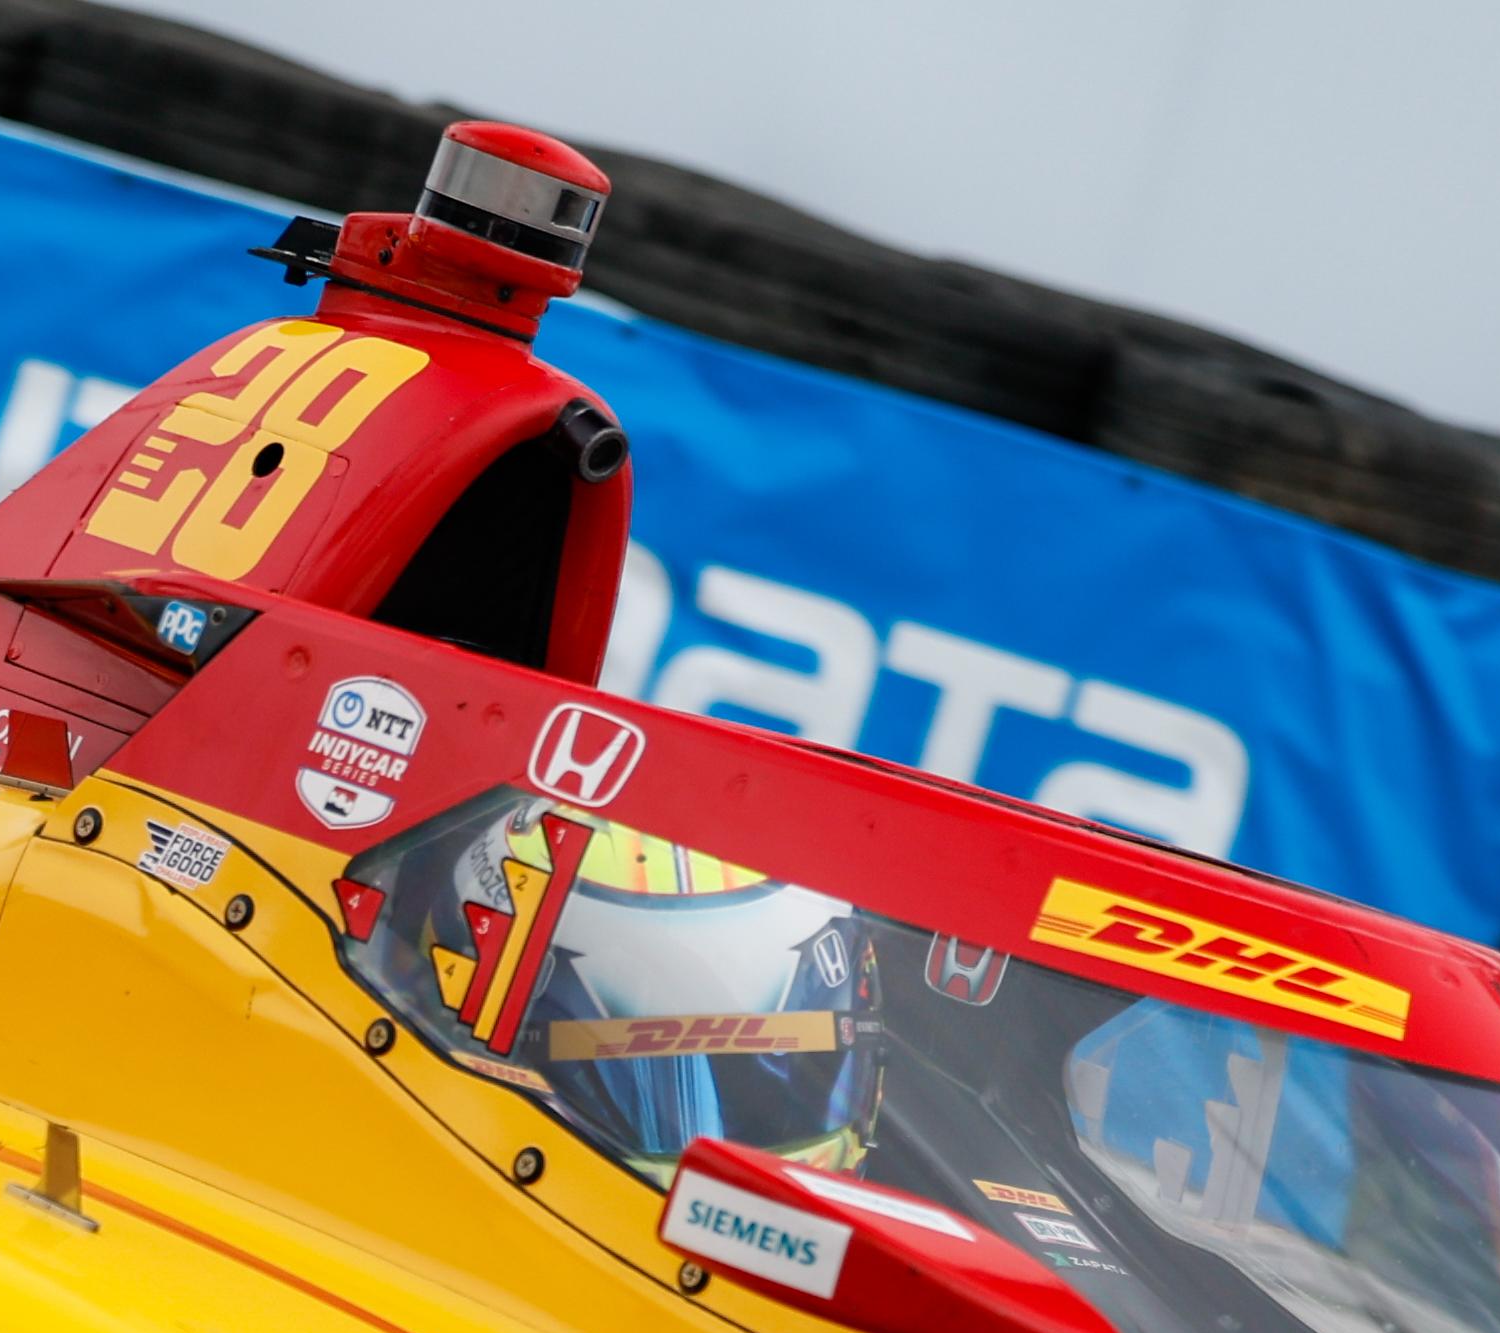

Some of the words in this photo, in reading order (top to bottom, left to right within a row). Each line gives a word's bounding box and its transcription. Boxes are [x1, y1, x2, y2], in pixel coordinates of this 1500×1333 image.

[85, 319, 430, 582] 28
[158, 607, 202, 644] PPG
[366, 707, 414, 739] NTT
[307, 731, 408, 781] INDYCAR
[321, 759, 380, 786] SERIES
[166, 852, 215, 882] GOOD
[171, 834, 224, 867] FORCE
[1088, 905, 1357, 1008] DHL
[625, 1018, 774, 1052] DHL
[994, 1187, 1059, 1208] DHL
[687, 1200, 818, 1266] SIEMENS
